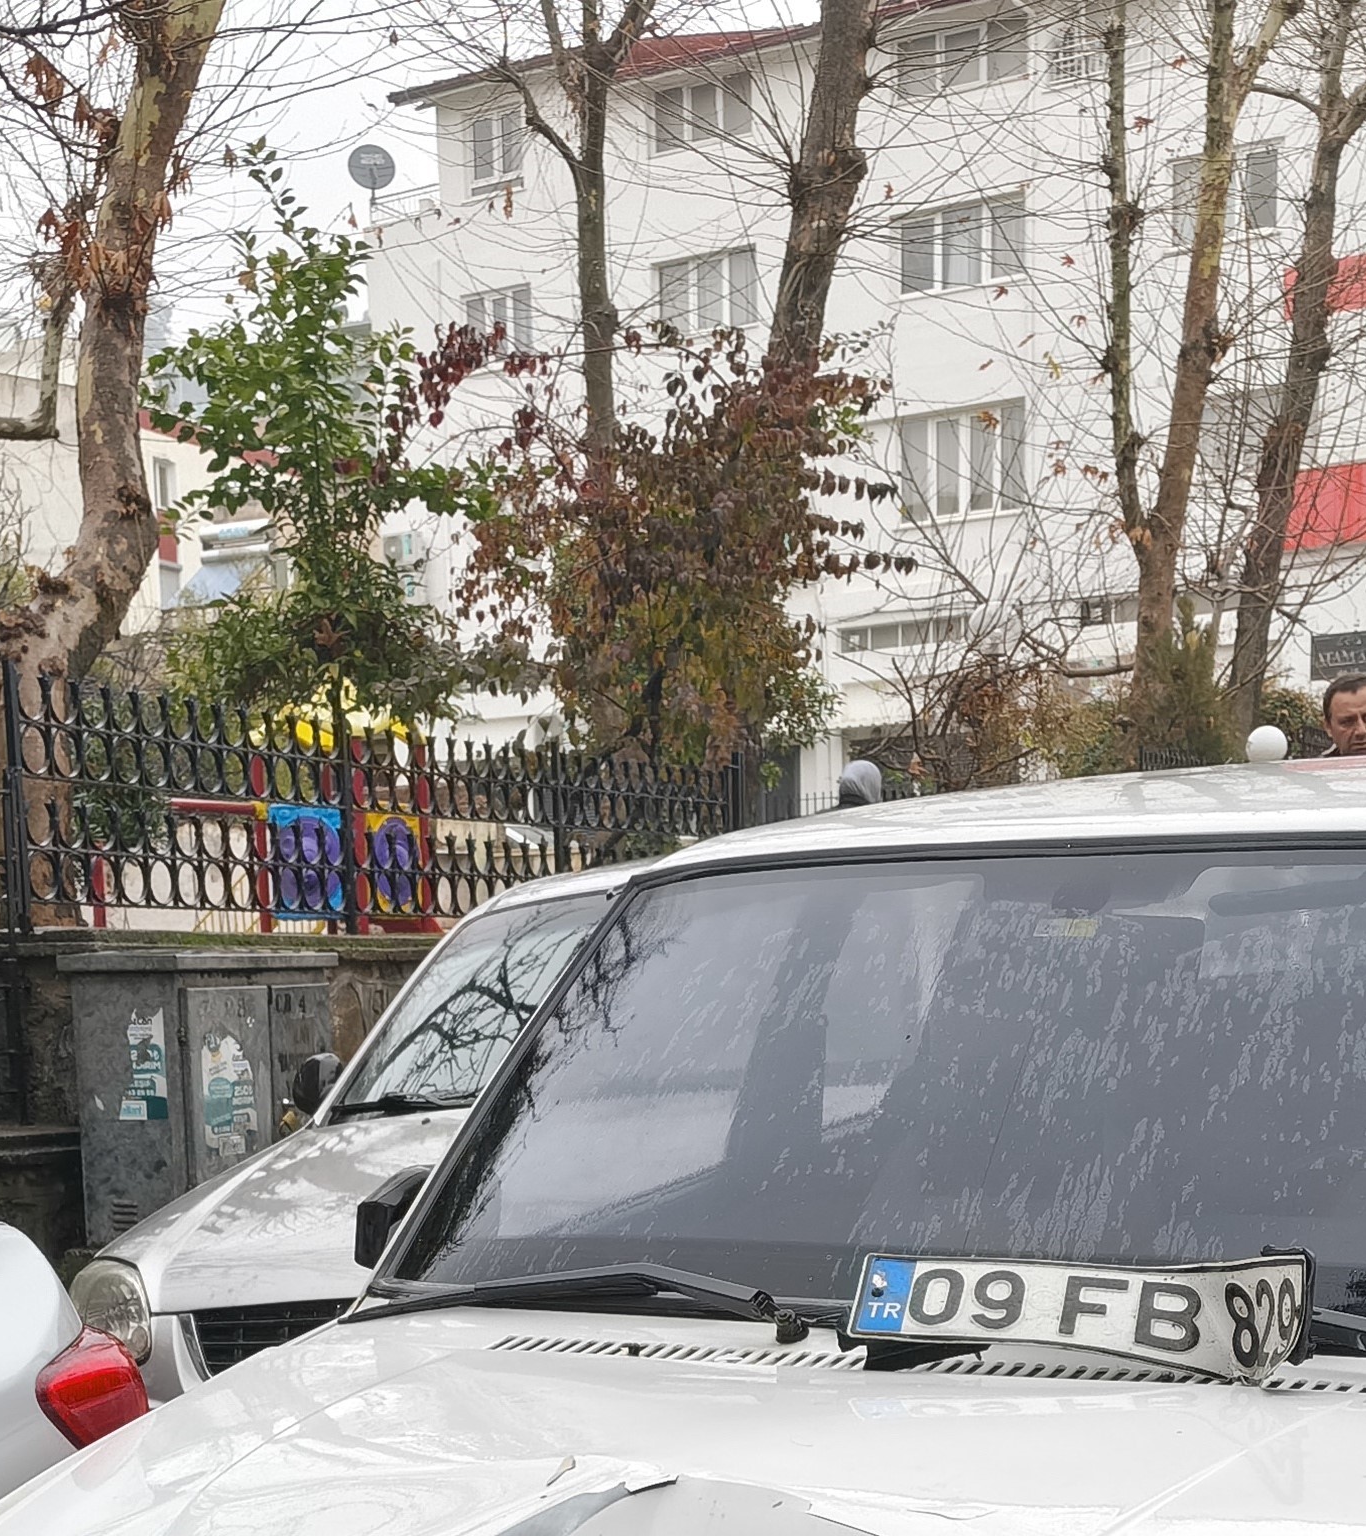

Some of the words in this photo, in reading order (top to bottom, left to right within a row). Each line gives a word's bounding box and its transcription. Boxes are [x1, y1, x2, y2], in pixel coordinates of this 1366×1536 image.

[868, 1302, 901, 1320] TR
[909, 1269, 1026, 1330] 09
[1059, 1276, 1202, 1352] FB
